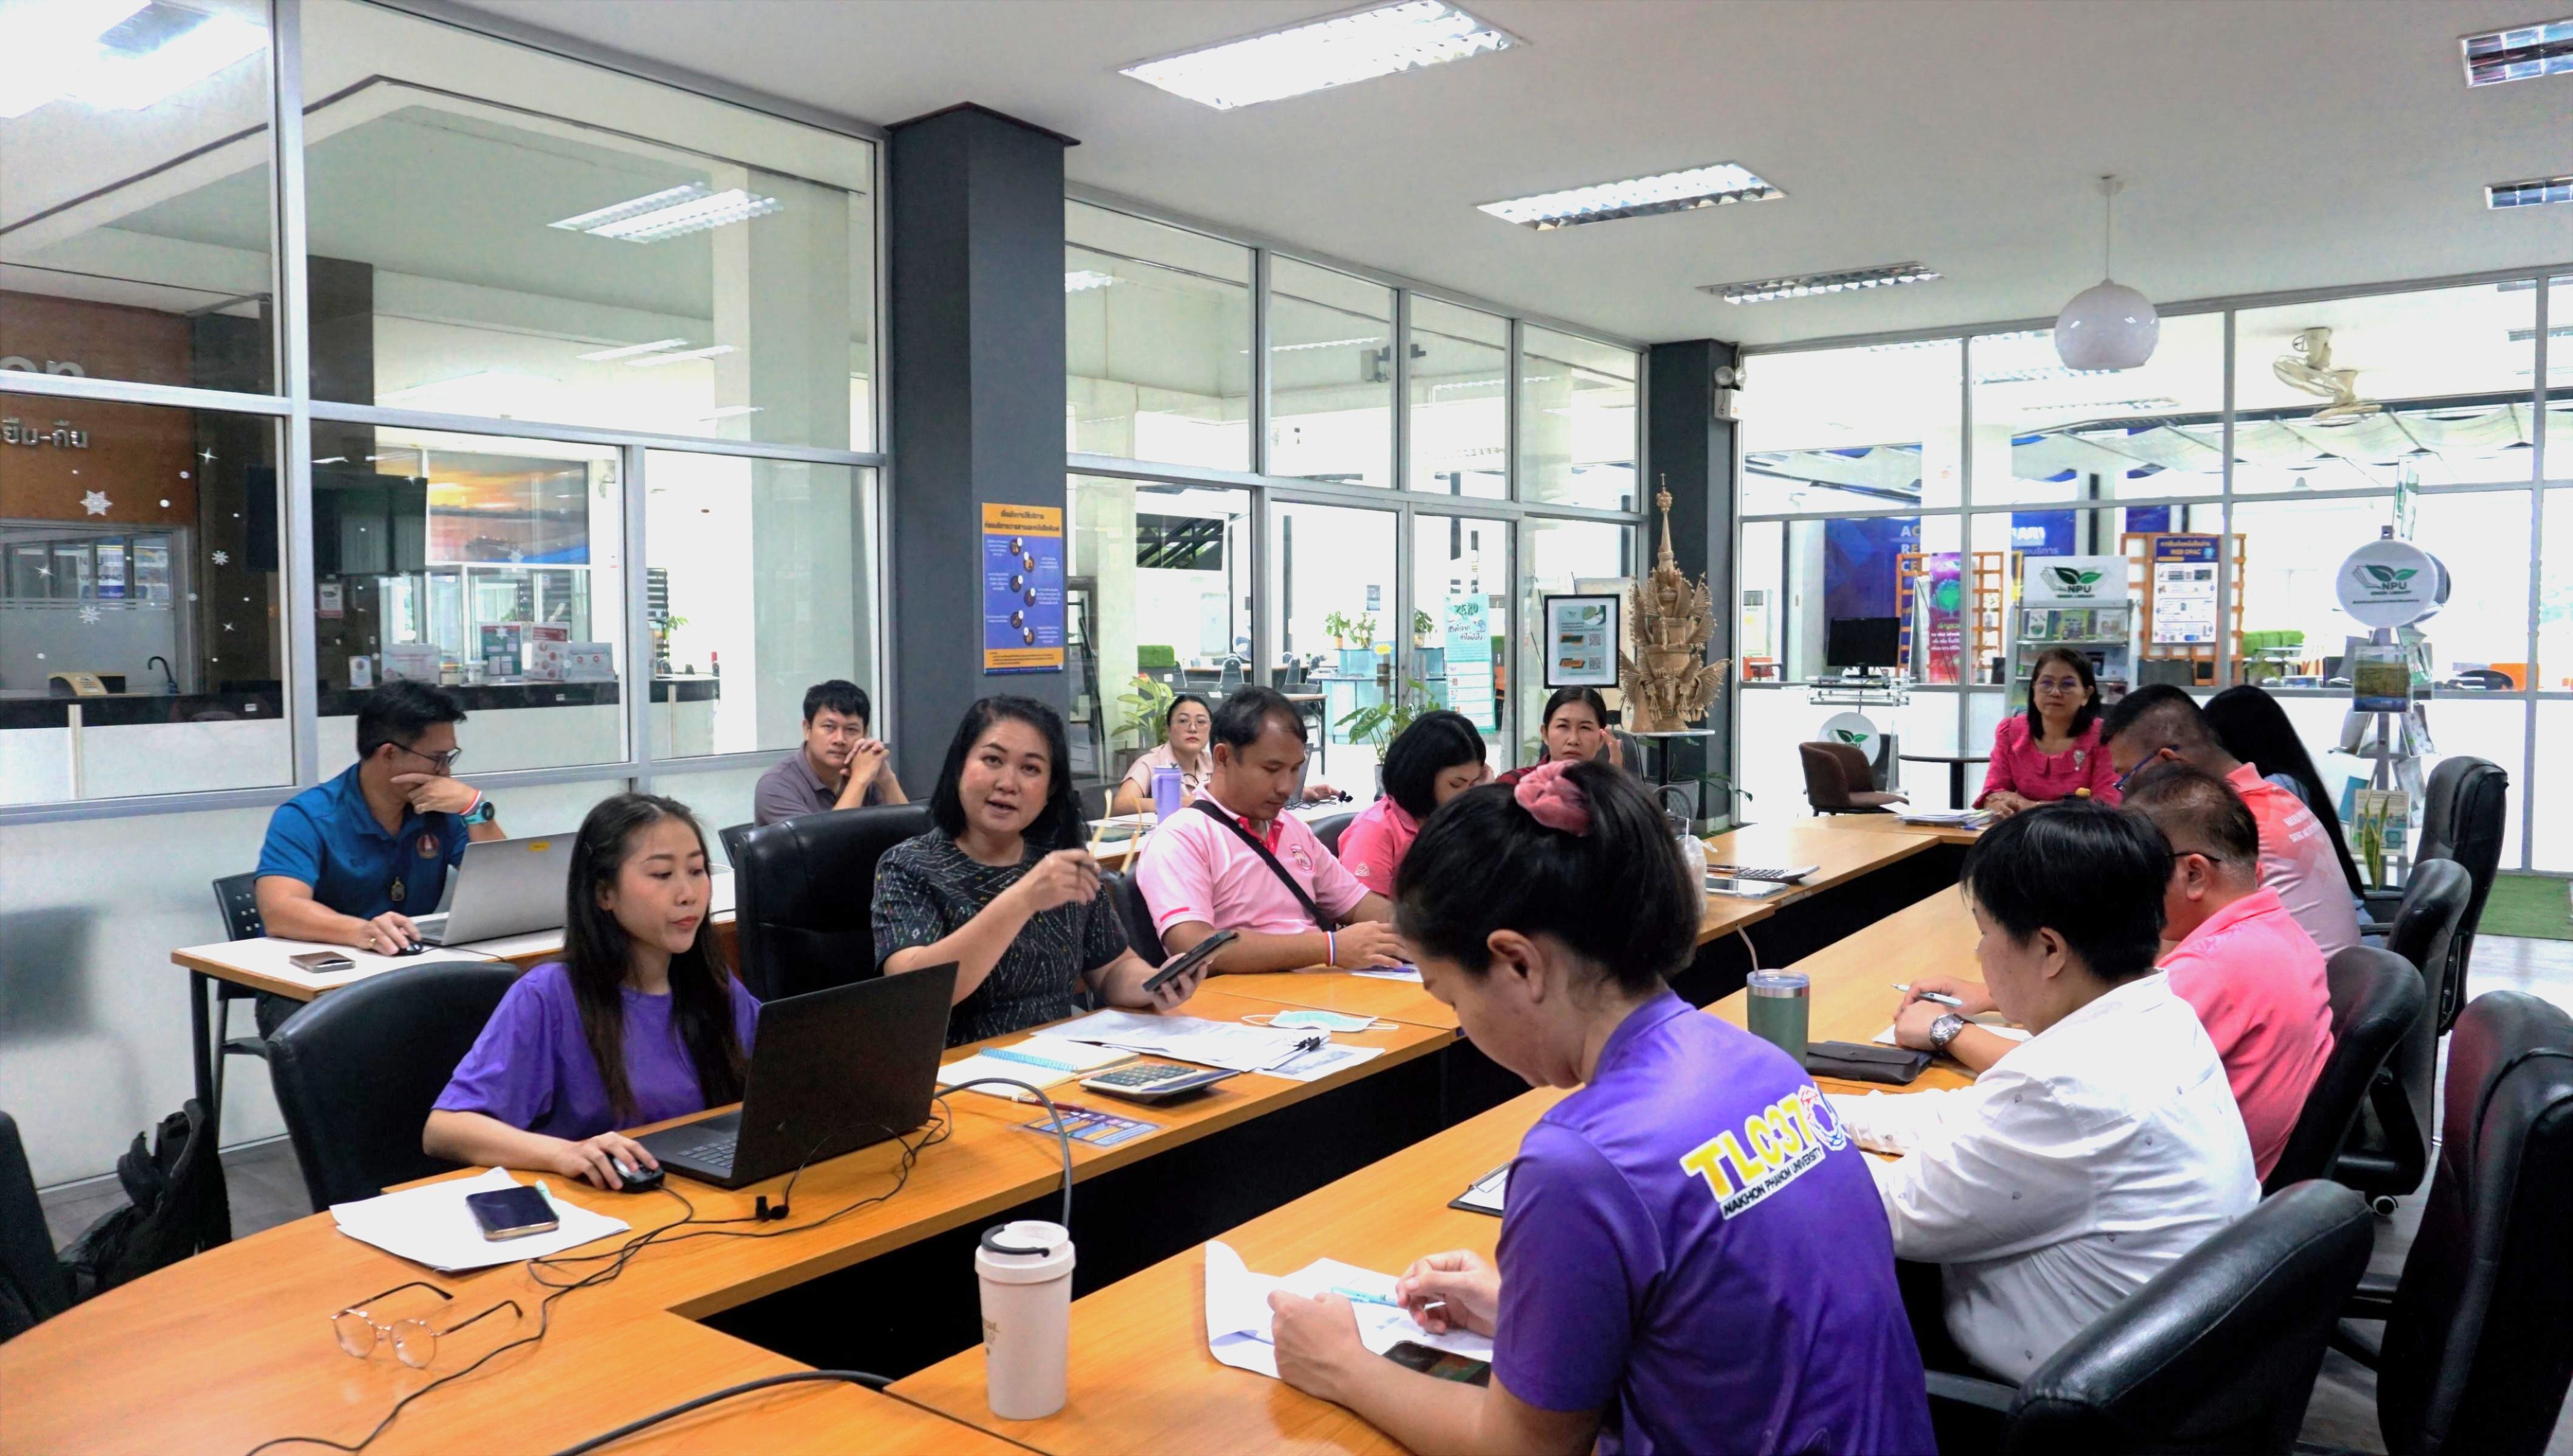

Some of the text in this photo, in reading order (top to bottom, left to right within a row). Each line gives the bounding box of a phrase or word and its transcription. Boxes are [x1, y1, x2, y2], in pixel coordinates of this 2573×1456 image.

[2068, 585, 2092, 593] NPU
[1723, 1147, 1824, 1216] NAKHON PHANOM UNIVERSITY
